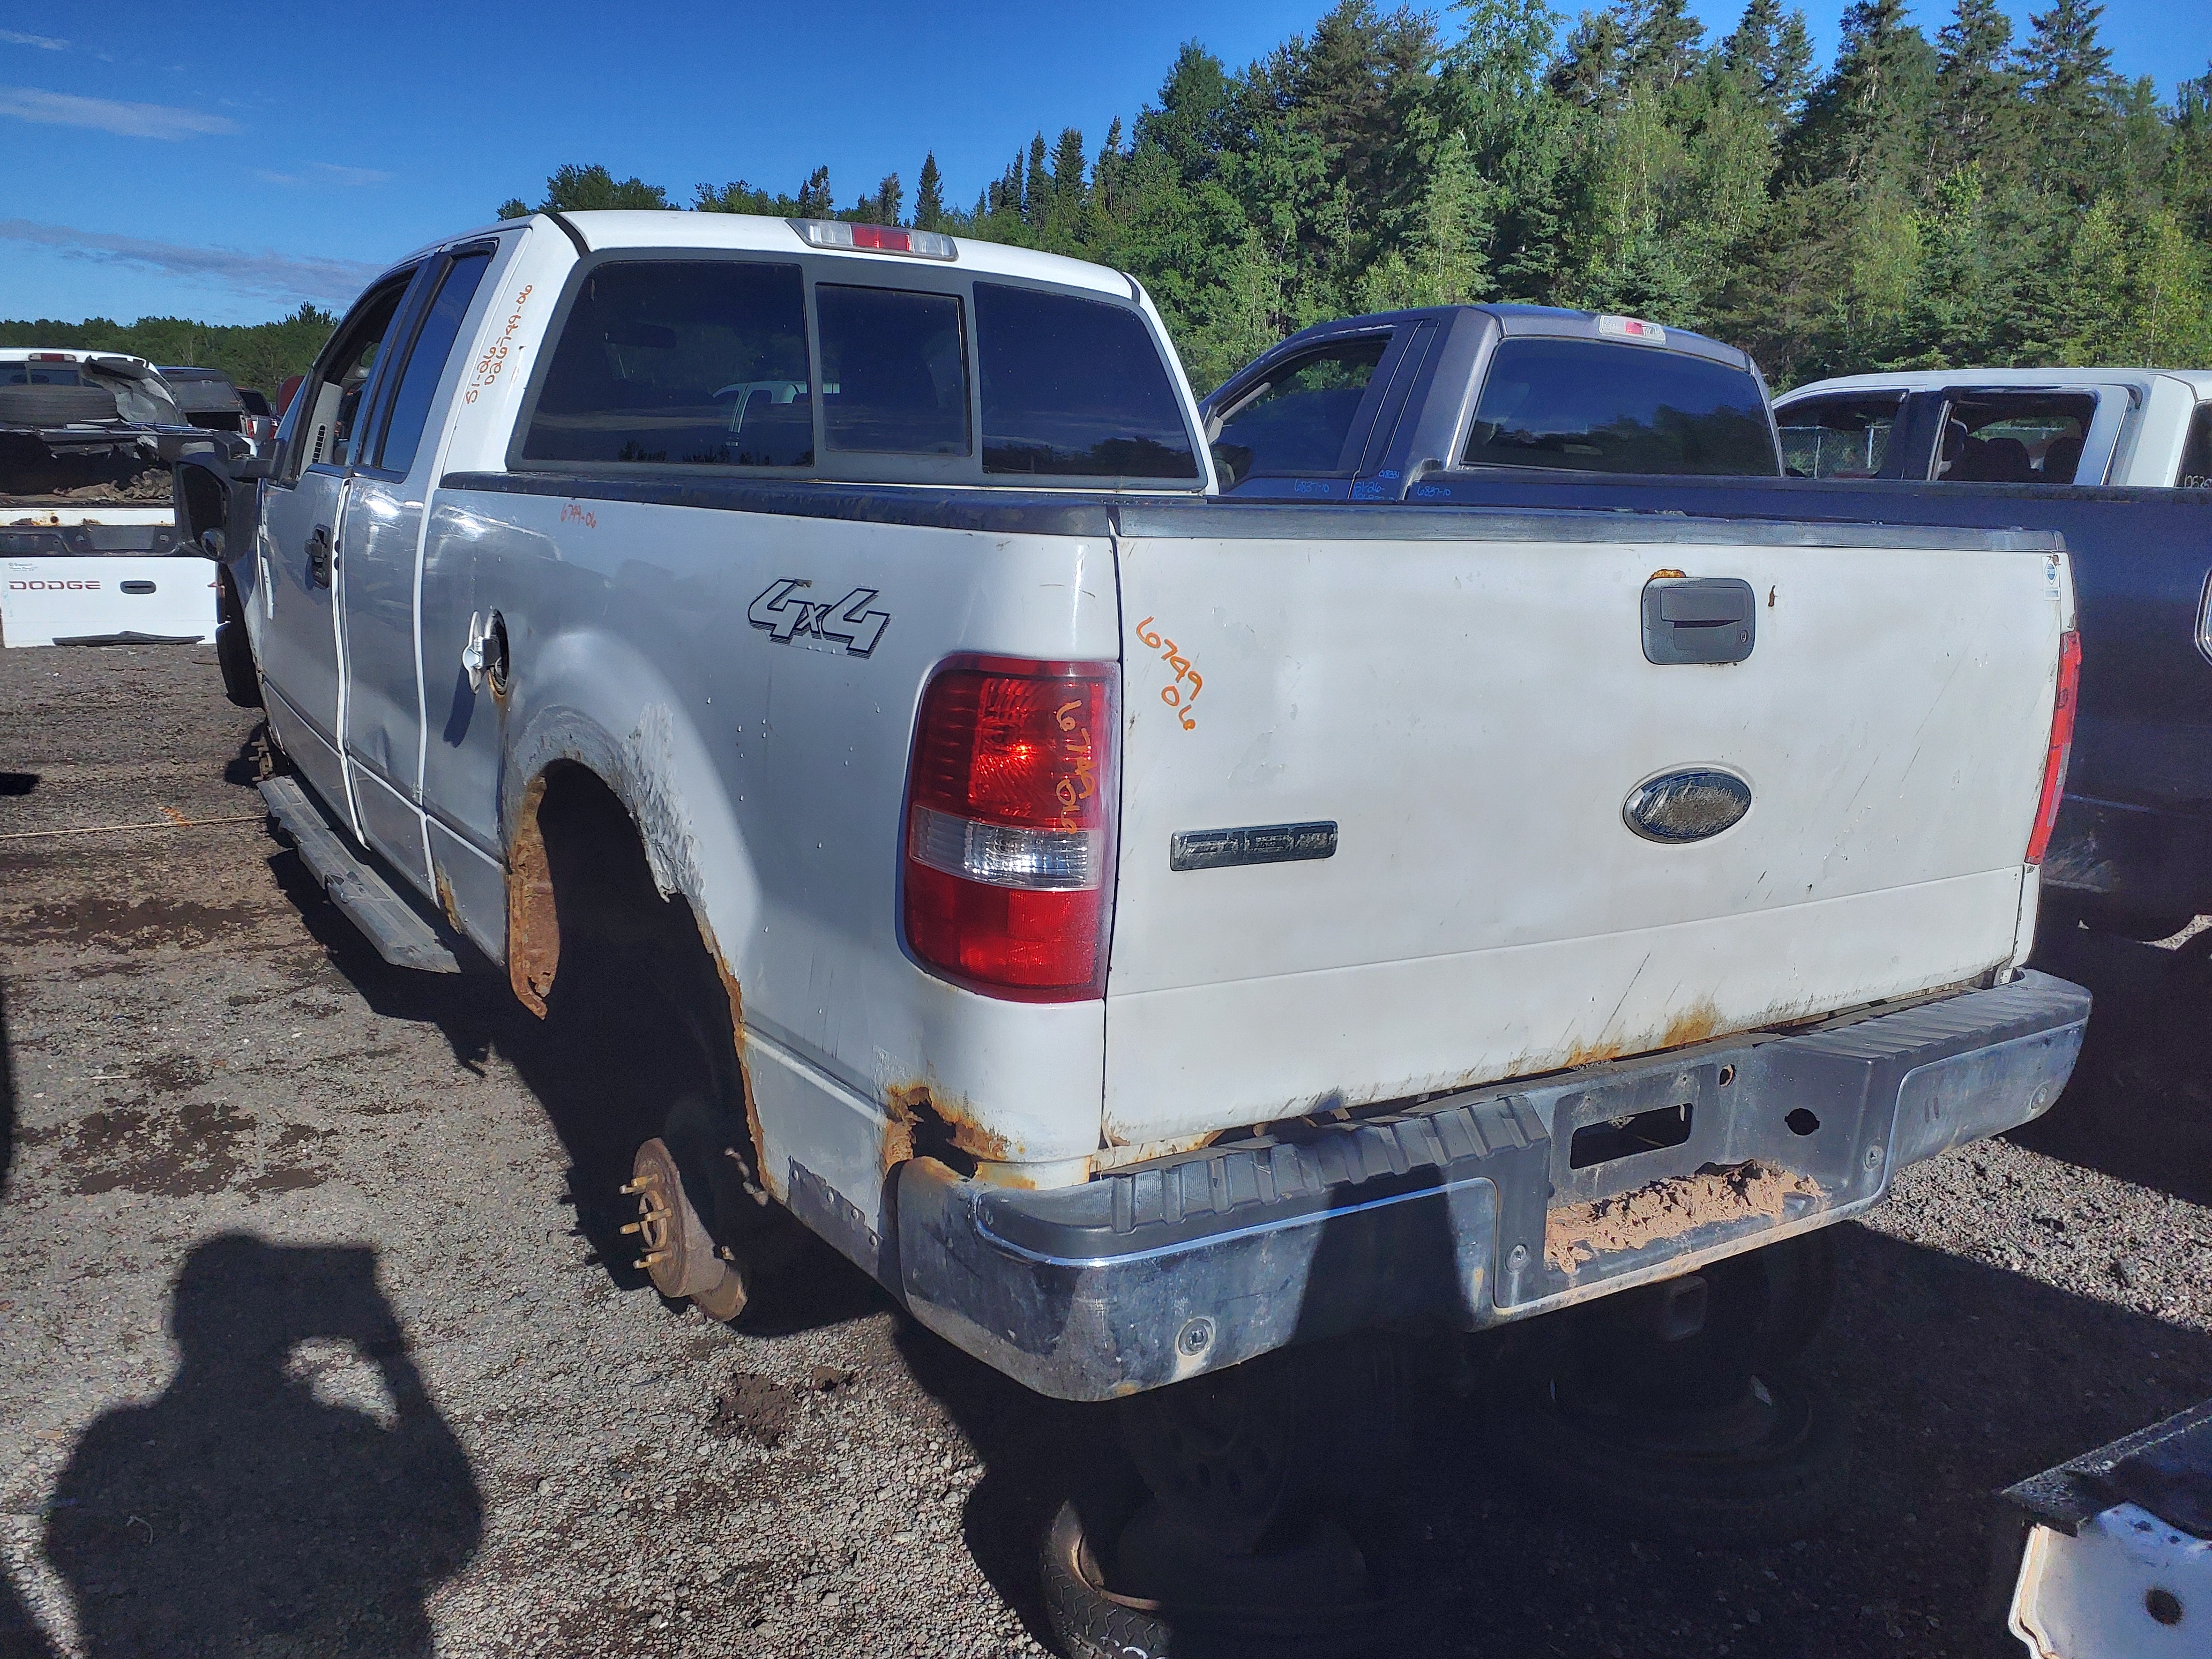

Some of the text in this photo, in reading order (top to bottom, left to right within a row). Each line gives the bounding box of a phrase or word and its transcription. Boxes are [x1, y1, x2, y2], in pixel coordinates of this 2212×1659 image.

[1417, 485, 1451, 497] 6837-10
[9, 580, 101, 590] DODGE
[1136, 616, 1203, 701] 6749
[1161, 685, 1196, 730] 06
